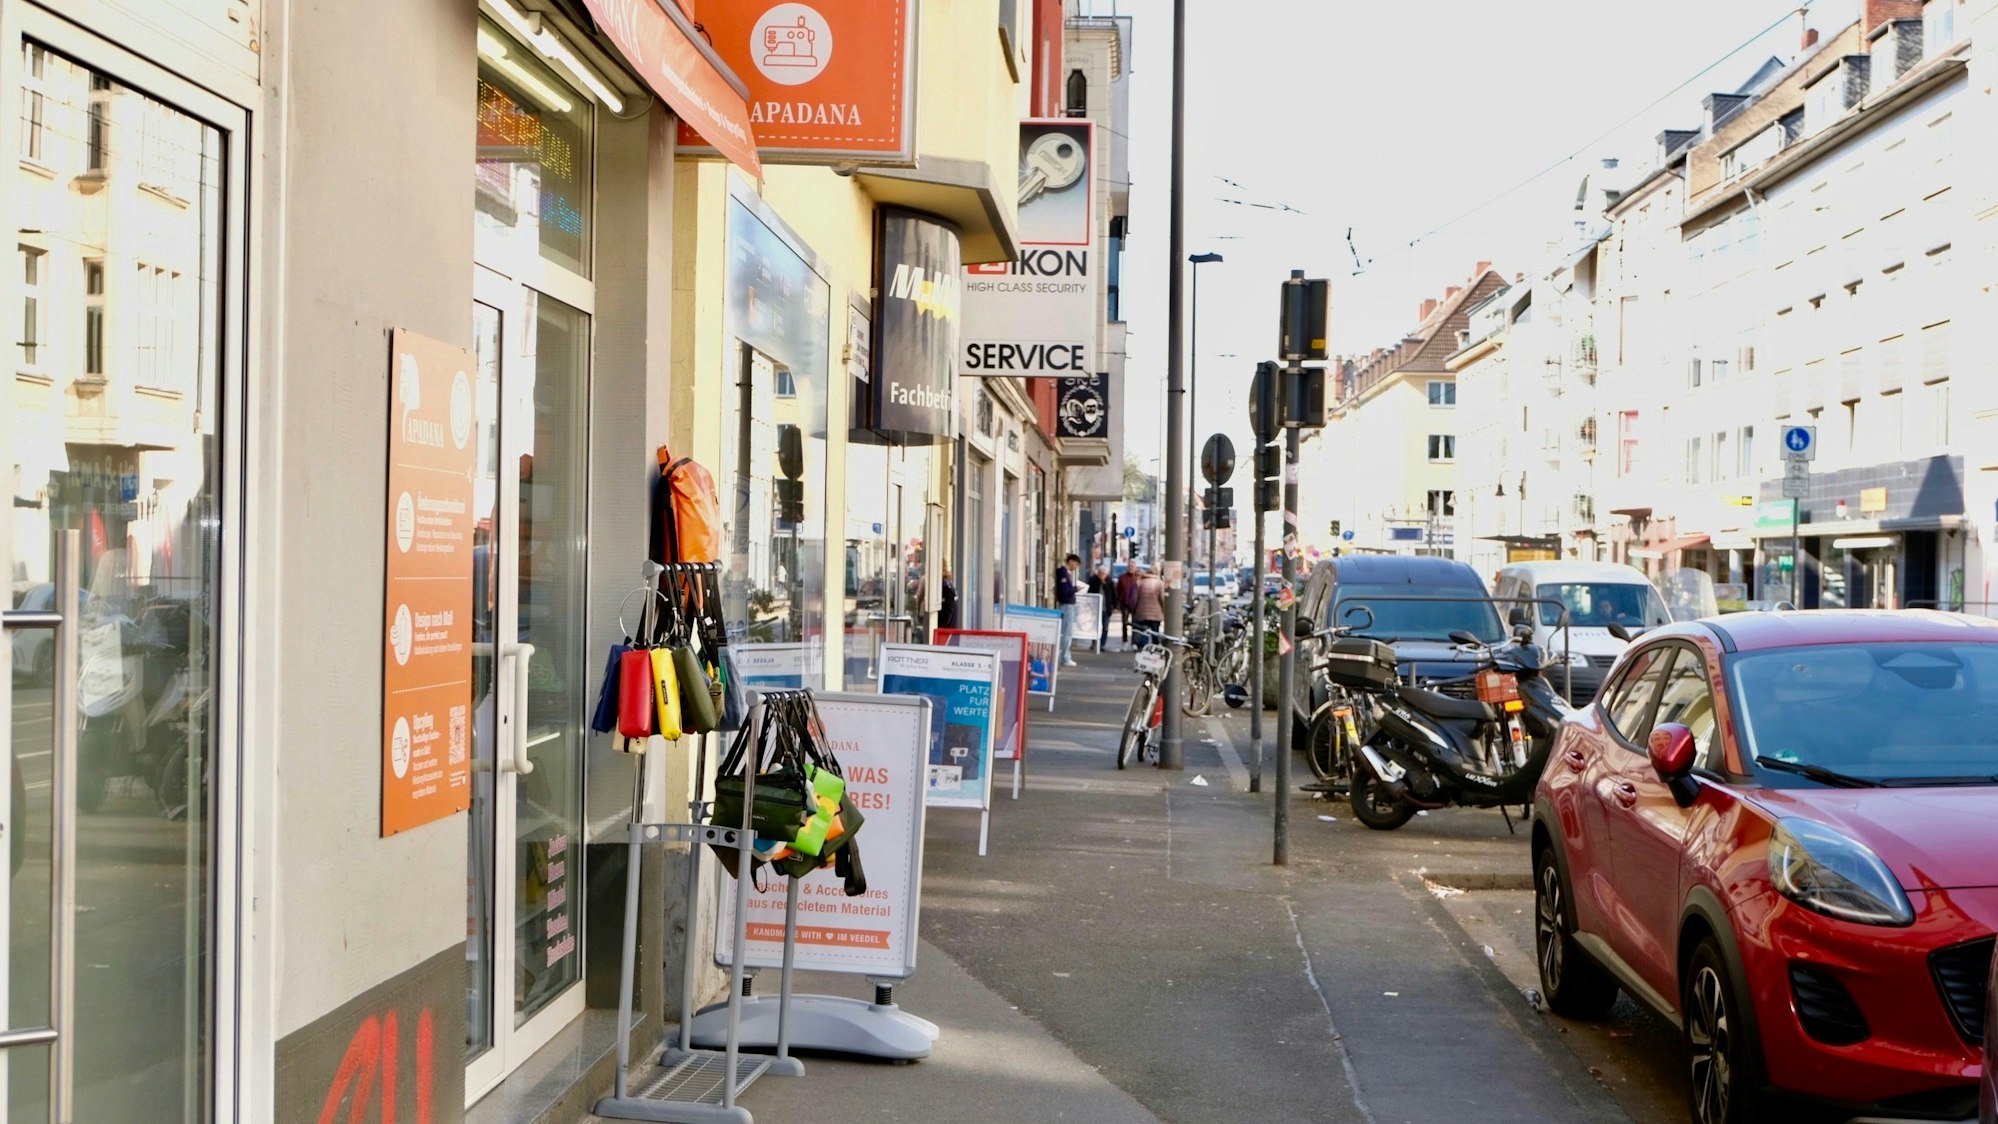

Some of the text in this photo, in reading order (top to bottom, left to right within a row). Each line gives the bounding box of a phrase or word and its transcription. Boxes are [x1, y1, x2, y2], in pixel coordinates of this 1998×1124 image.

[750, 102, 862, 126] APADANA
[1011, 250, 1087, 276] IKON
[967, 282, 1086, 293] HIGH CLASS SECURITY
[966, 343, 1084, 370] SERVICE
[887, 655, 929, 664] ROTTNER
[959, 684, 990, 695] PLATZ
[953, 706, 988, 717] WERTE
[831, 741, 860, 751] DANA
[847, 766, 889, 784] WAS
[849, 791, 890, 809] RES!
[803, 884, 812, 895] &
[816, 884, 888, 900] Acceoires
[747, 899, 891, 917] aus reccletem Material
[753, 927, 880, 944] HANDMAE WITH IM VEEDEL
